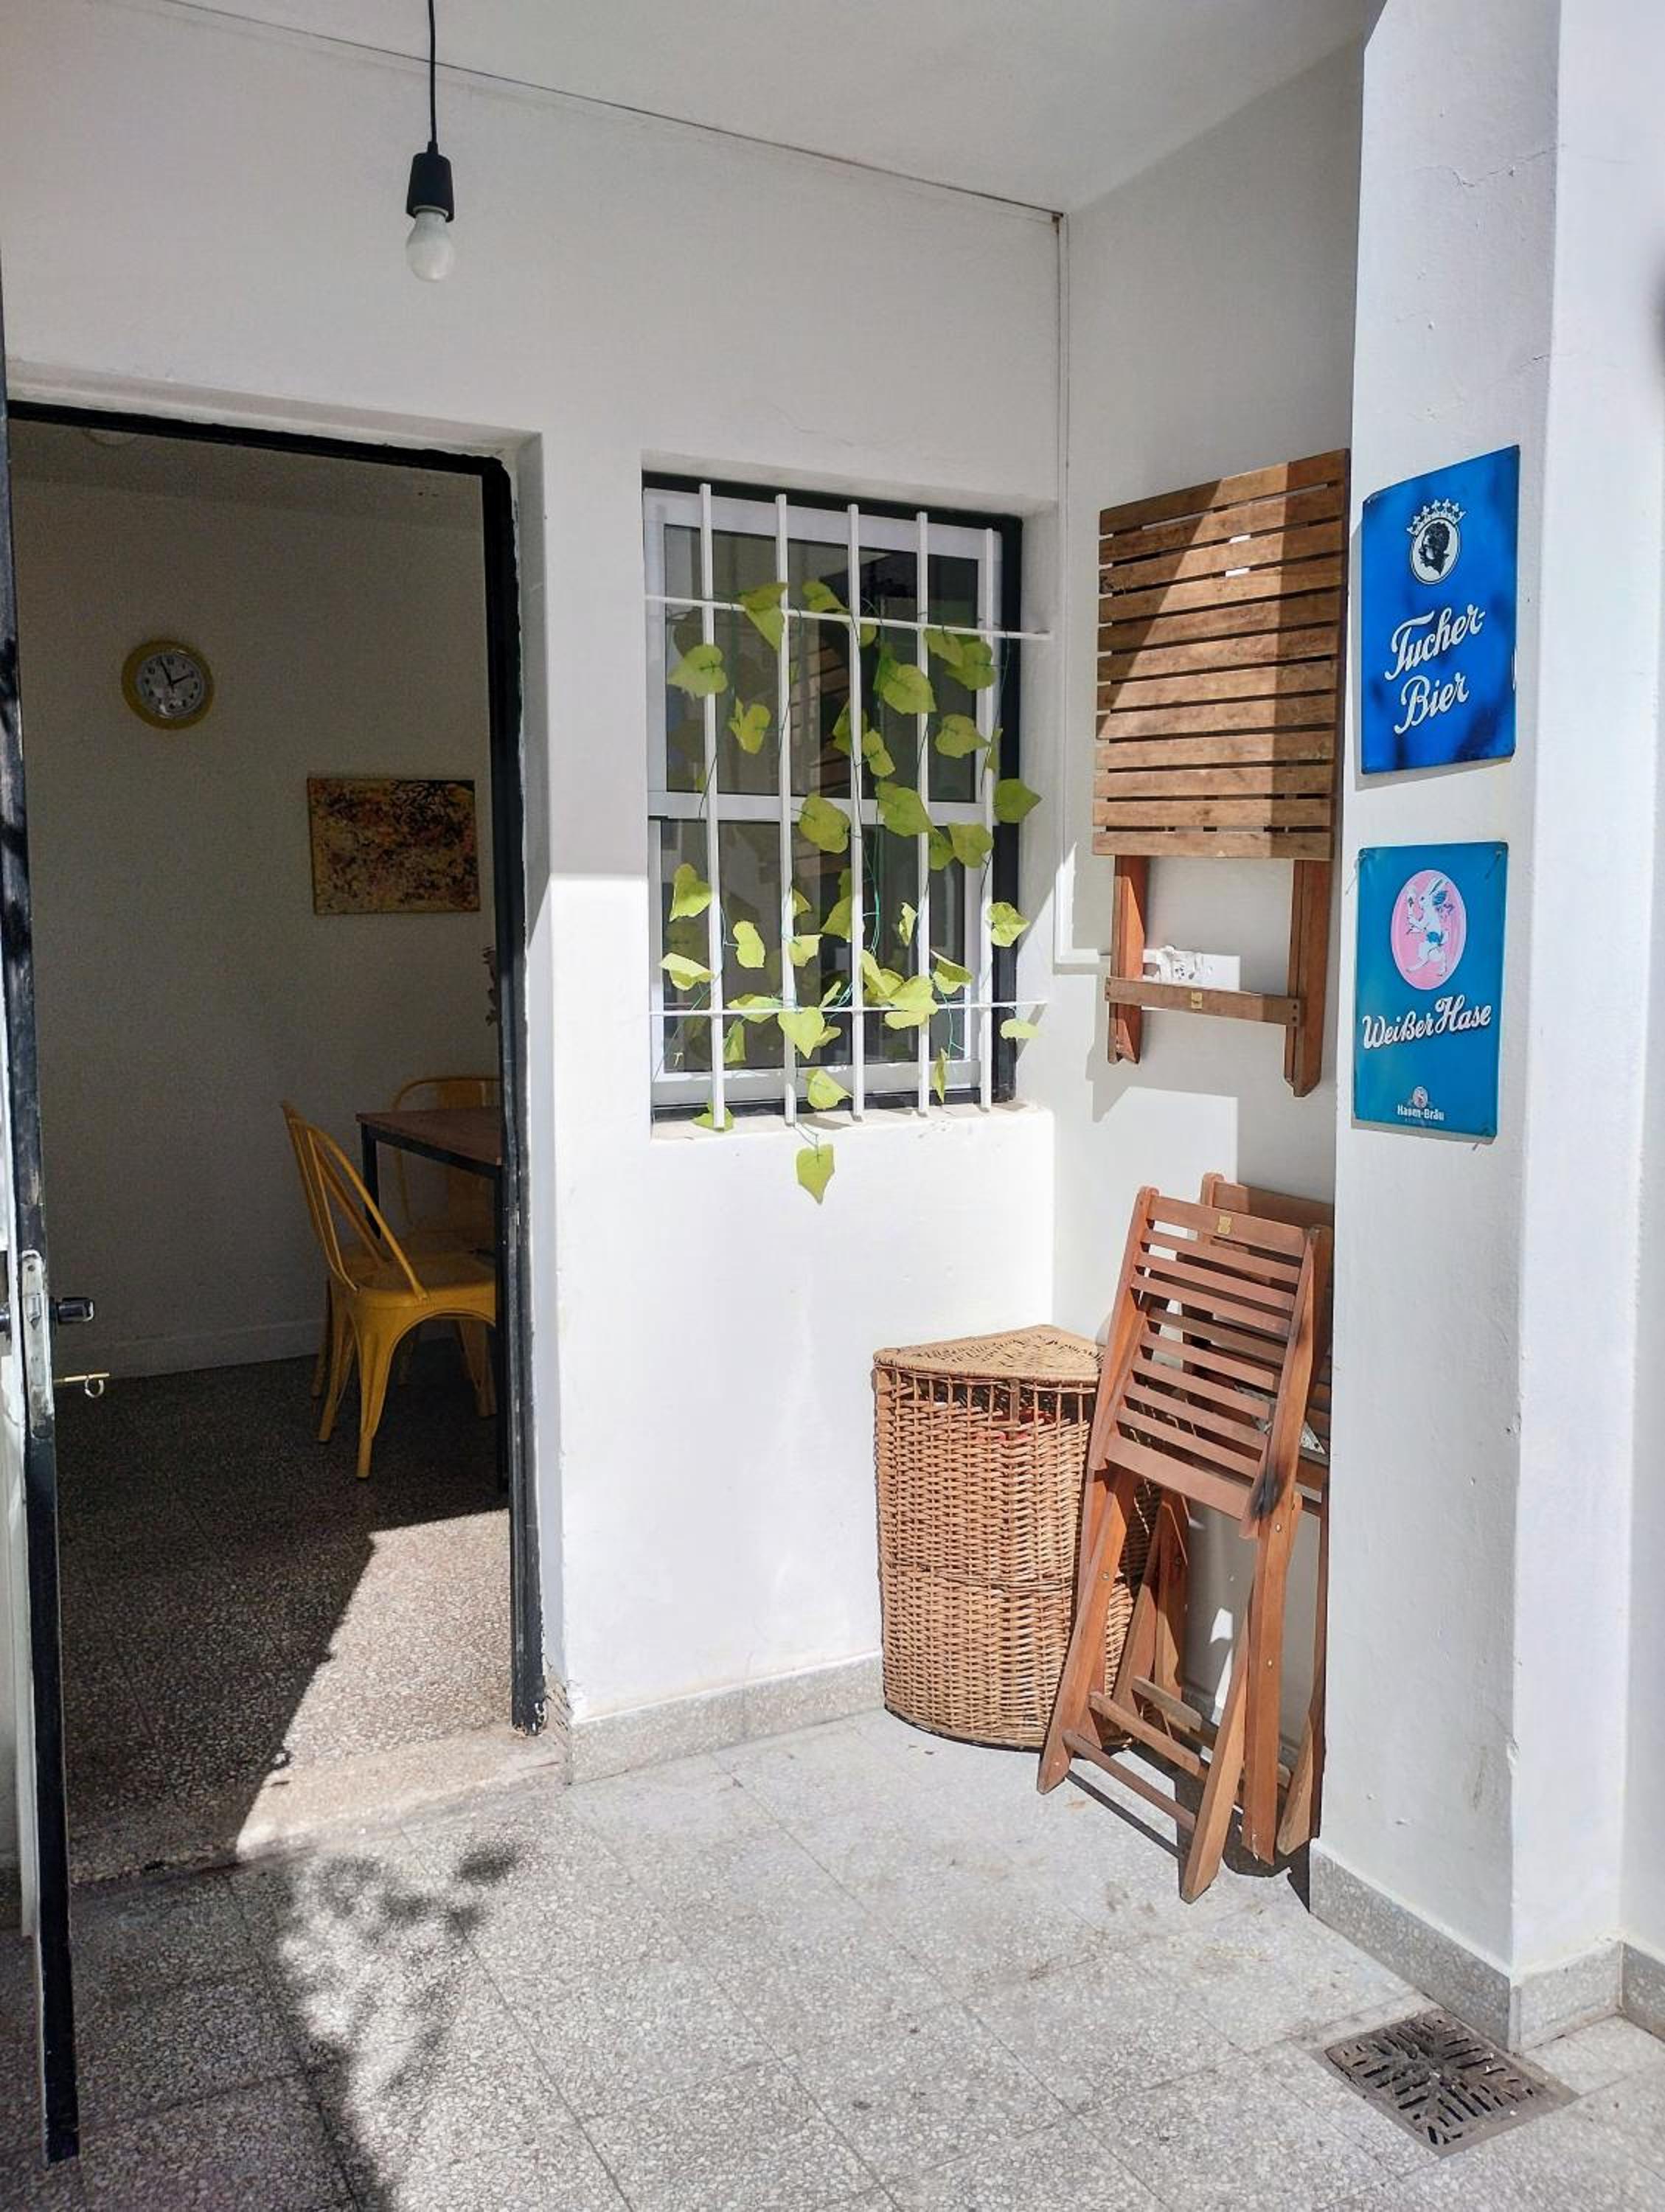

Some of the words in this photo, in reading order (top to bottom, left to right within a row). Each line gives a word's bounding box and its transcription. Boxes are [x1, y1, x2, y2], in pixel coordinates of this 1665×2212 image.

[1394, 672, 1469, 734] Bier
[1363, 1011, 1434, 1049] Weißer
[1435, 995, 1492, 1034] Hase
